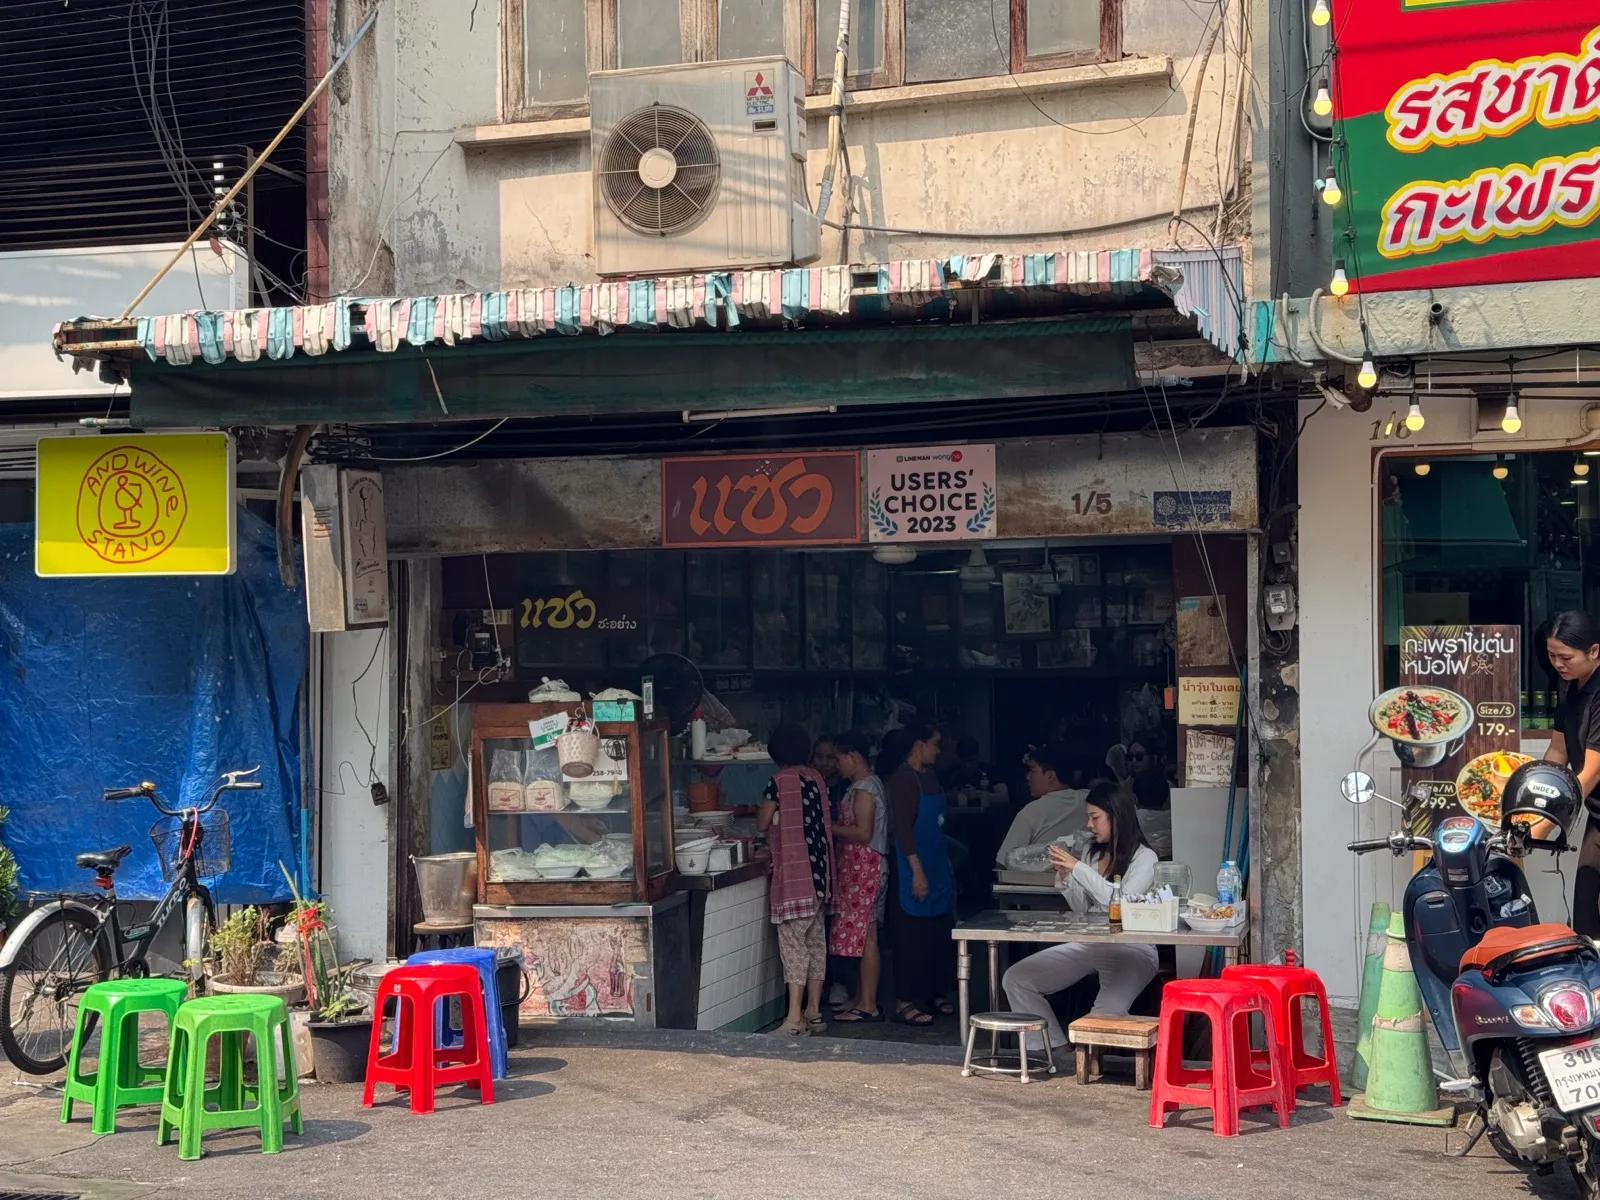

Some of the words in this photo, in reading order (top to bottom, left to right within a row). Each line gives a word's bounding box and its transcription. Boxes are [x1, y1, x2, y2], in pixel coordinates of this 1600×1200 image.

[87, 453, 129, 497] AND
[884, 492, 978, 514] CHOICE
[1071, 491, 1112, 516] 1/5
[906, 515, 957, 534] 2023
[87, 529, 166, 560] STAND
[1404, 632, 1515, 660] กะเพราไข่ตุ๋น
[1404, 653, 1470, 676] หม้อไฟ
[1479, 704, 1512, 716] Size/S
[1478, 722, 1516, 737] 179.-
[1532, 784, 1556, 796] INDEX
[1569, 1081, 1600, 1103] 70
